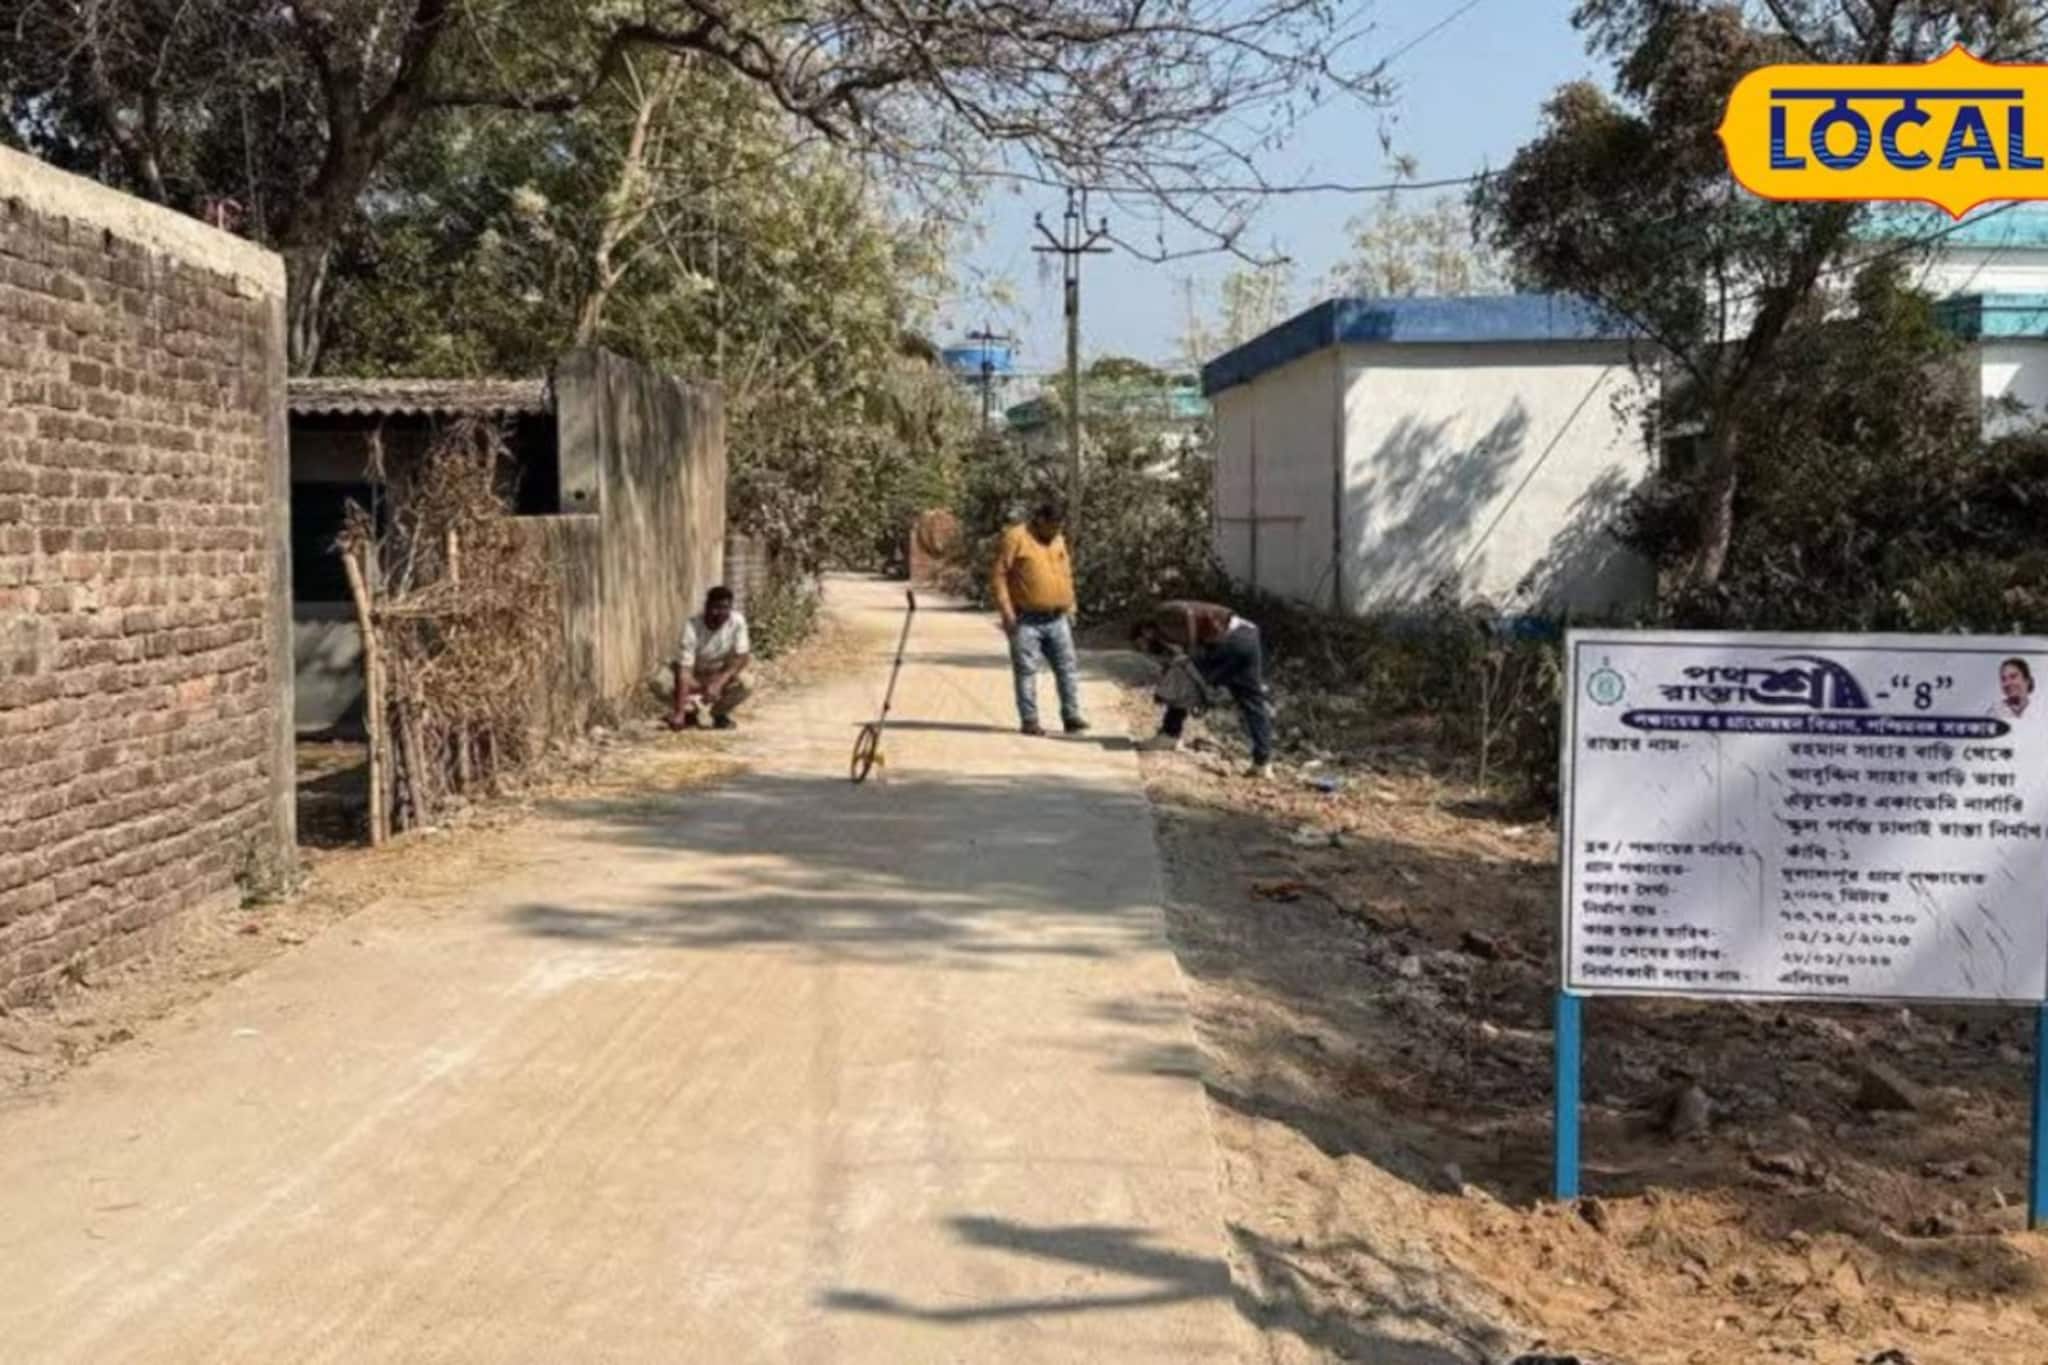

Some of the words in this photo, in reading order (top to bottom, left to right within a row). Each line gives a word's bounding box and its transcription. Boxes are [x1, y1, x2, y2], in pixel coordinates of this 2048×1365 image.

[1587, 736, 1640, 752] রাস্তার
[1962, 745, 2013, 761] থেকে
[1938, 821, 1982, 838] রাস্তা
